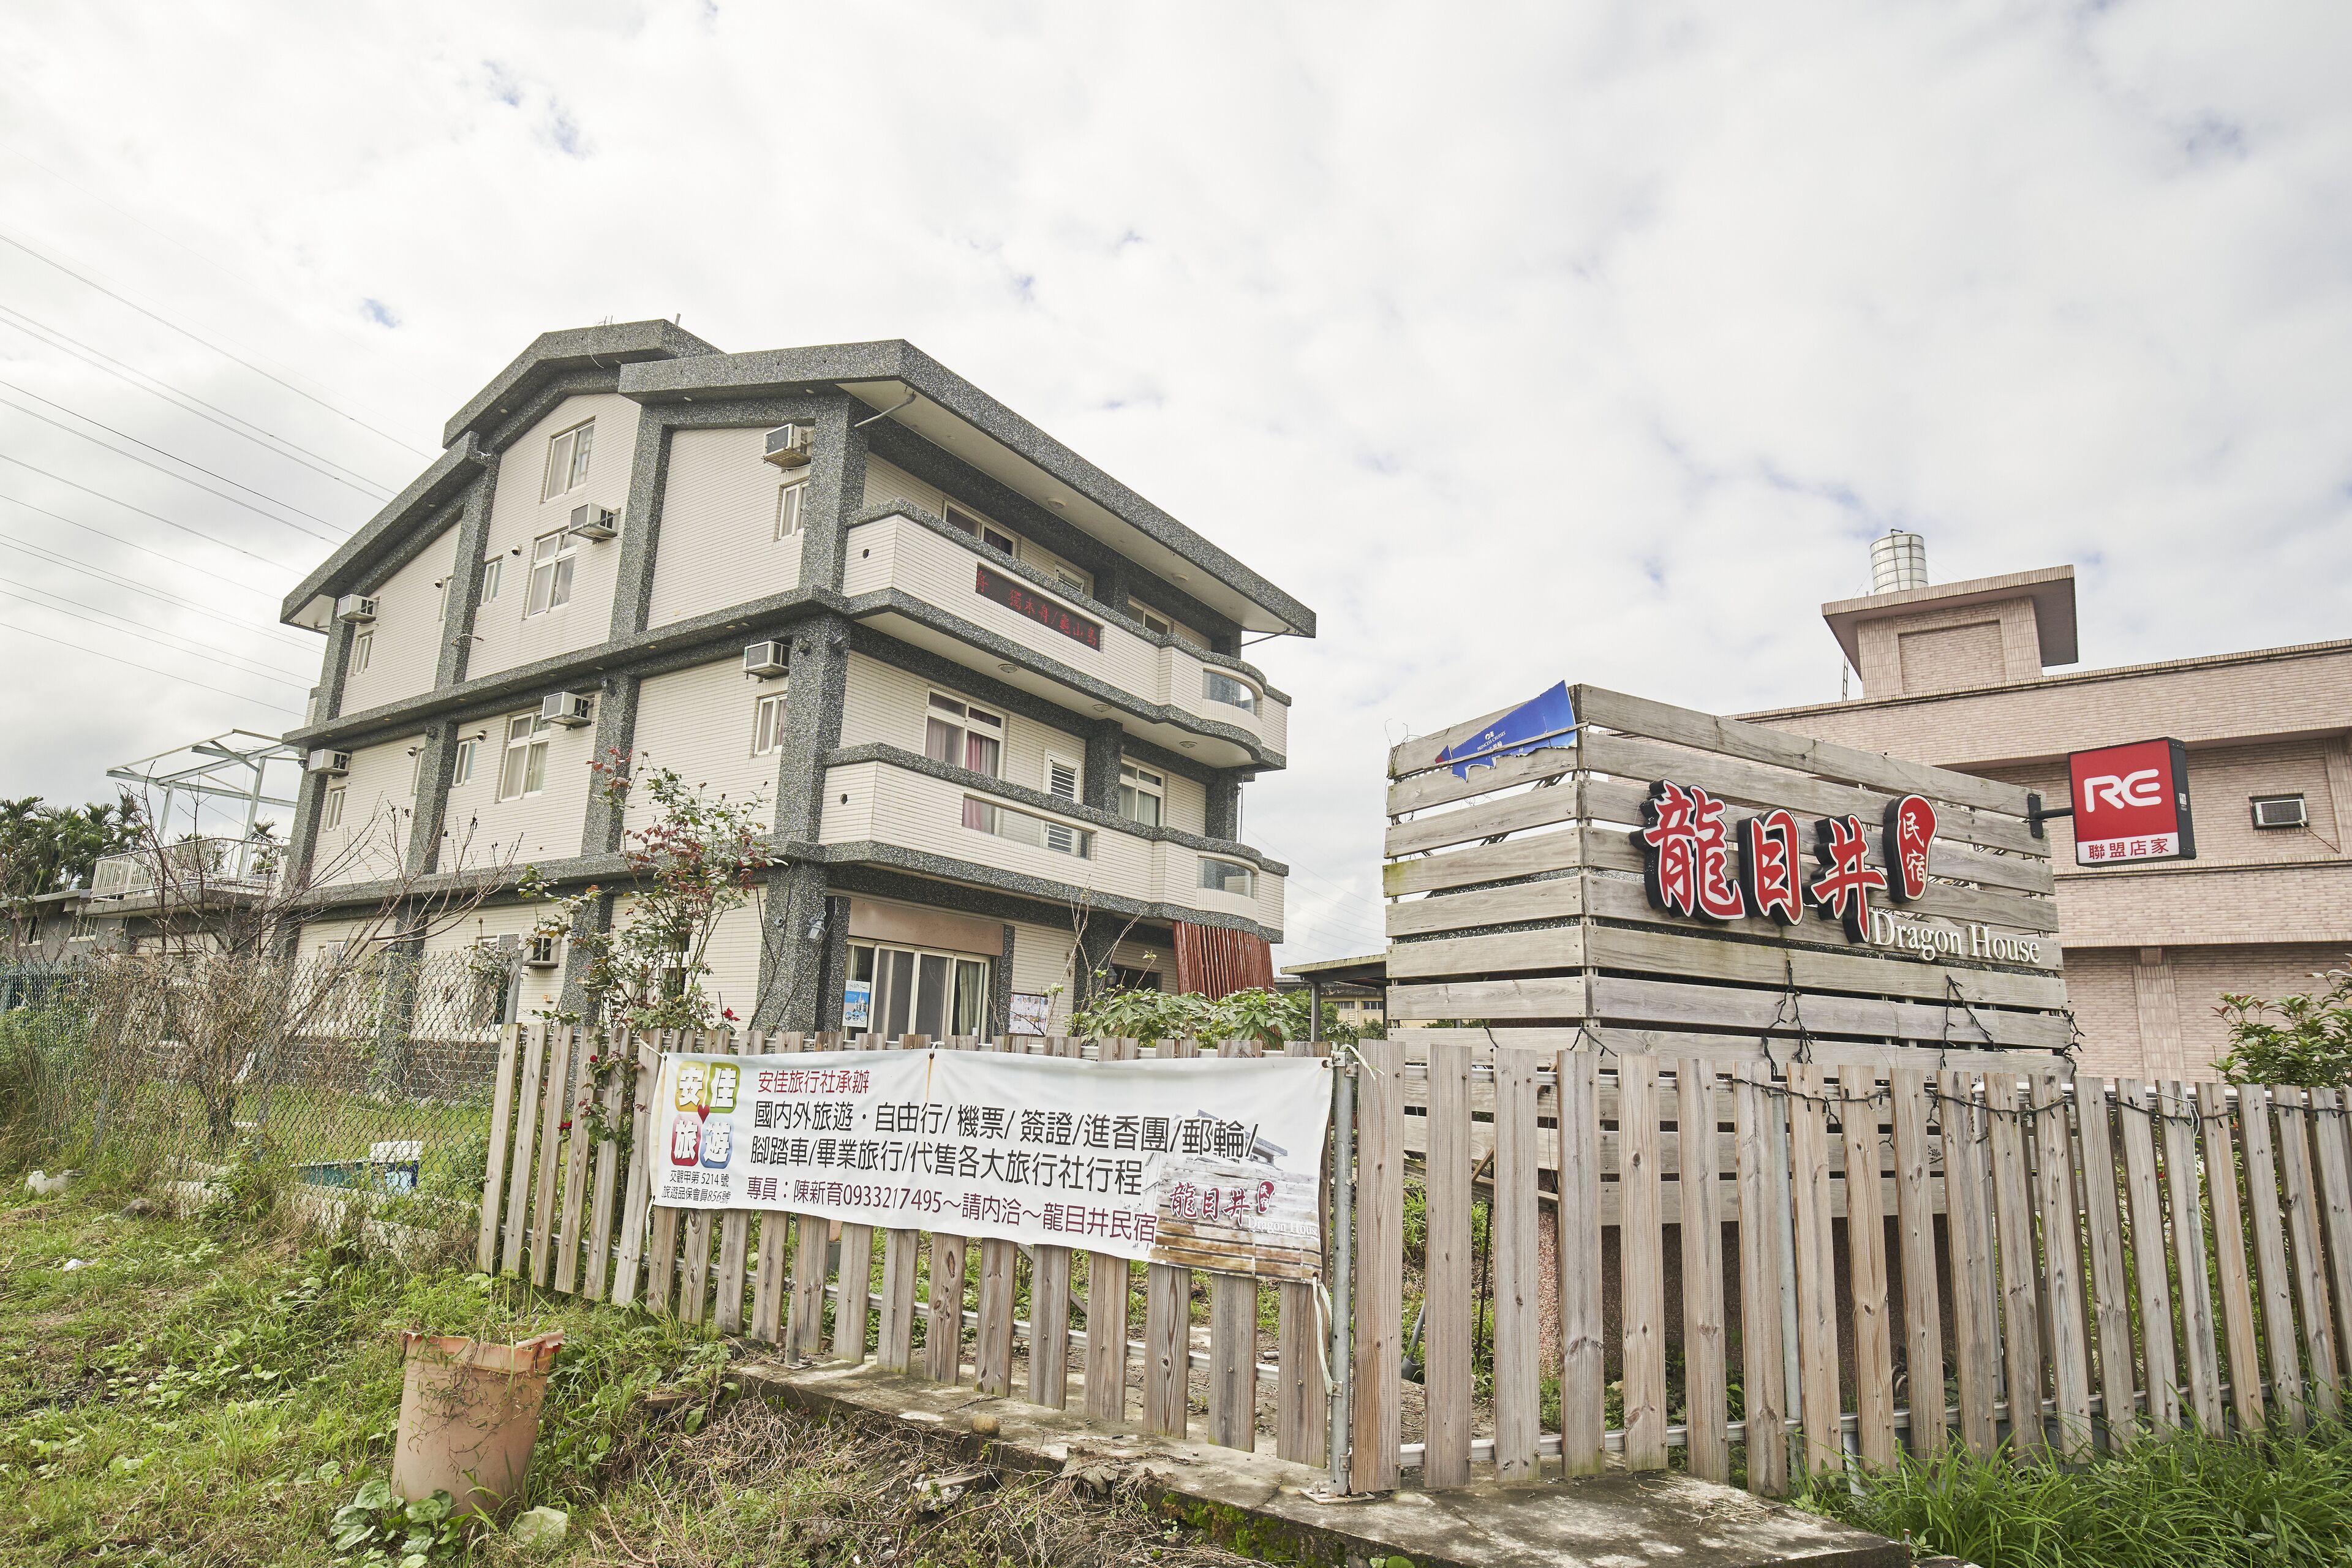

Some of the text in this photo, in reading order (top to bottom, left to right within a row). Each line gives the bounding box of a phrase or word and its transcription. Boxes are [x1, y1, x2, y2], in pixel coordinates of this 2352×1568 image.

[1477, 739, 1493, 752] PRINCESS
[1492, 730, 1506, 742] CRUISES
[1643, 778, 1888, 944] 龍目井
[1899, 811, 1926, 883] 民宿
[2088, 838, 2169, 860] 聯盟店家
[1869, 910, 2041, 963] Dragon House
[678, 1066, 737, 1109] 安佳
[758, 1069, 870, 1094] 安佳旅行社承辦
[674, 1120, 733, 1163] 旅遊
[1169, 1181, 1252, 1227] 龍目井
[1259, 1184, 1270, 1208] 民宿
[1247, 1216, 1285, 1233] Dragon
